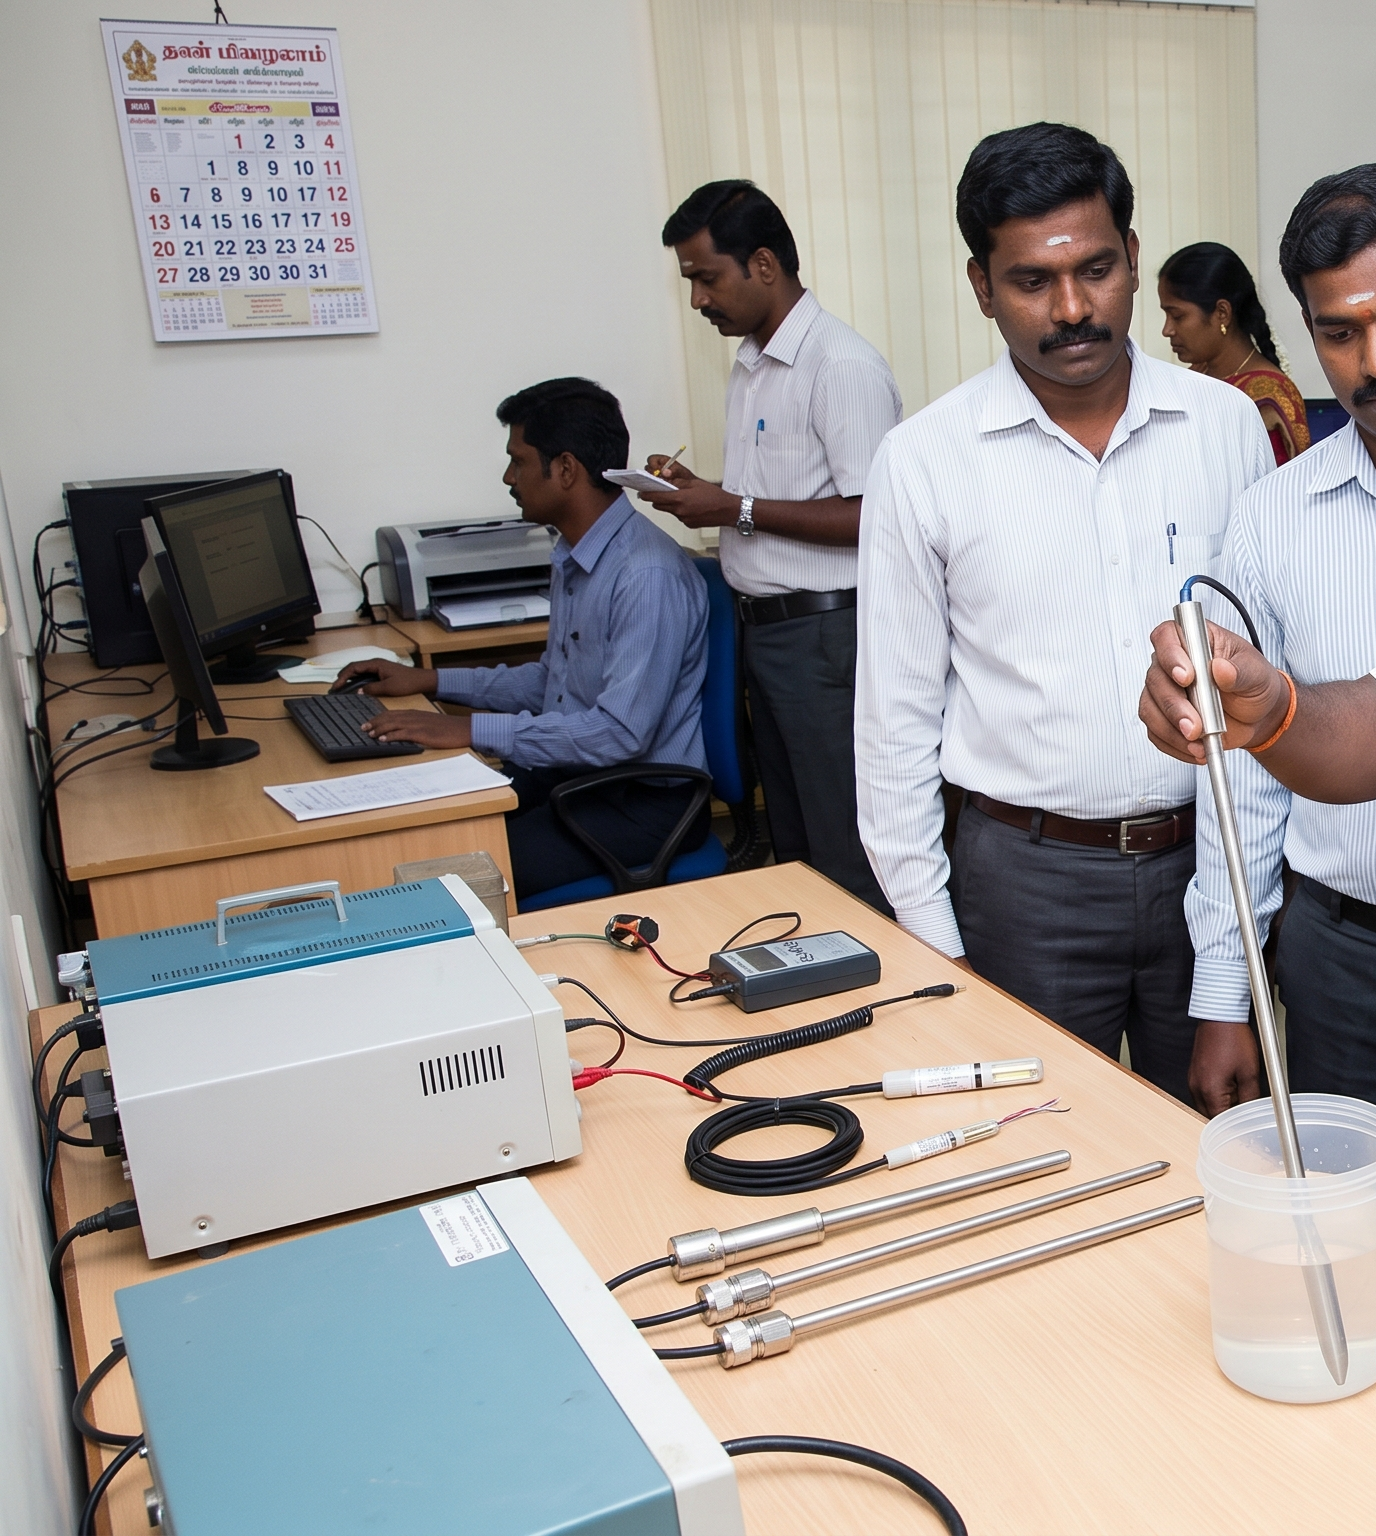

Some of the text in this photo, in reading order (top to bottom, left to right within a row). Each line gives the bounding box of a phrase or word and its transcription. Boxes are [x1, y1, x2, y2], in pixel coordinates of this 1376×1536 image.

[234, 133, 335, 150] 1 2 3 4
[206, 159, 342, 176] 1 8 9 10 11
[149, 185, 348, 204] 6 7 8 9 10 17 12
[148, 211, 352, 231] 13 14 15 16 17 17 19
[152, 237, 355, 258] 20 21 22 23 23 24 25
[156, 267, 179, 284] 27
[187, 266, 211, 283] 28
[218, 265, 241, 282] 29
[248, 265, 271, 282] 30
[278, 264, 301, 281] 30
[308, 263, 328, 280] 31
